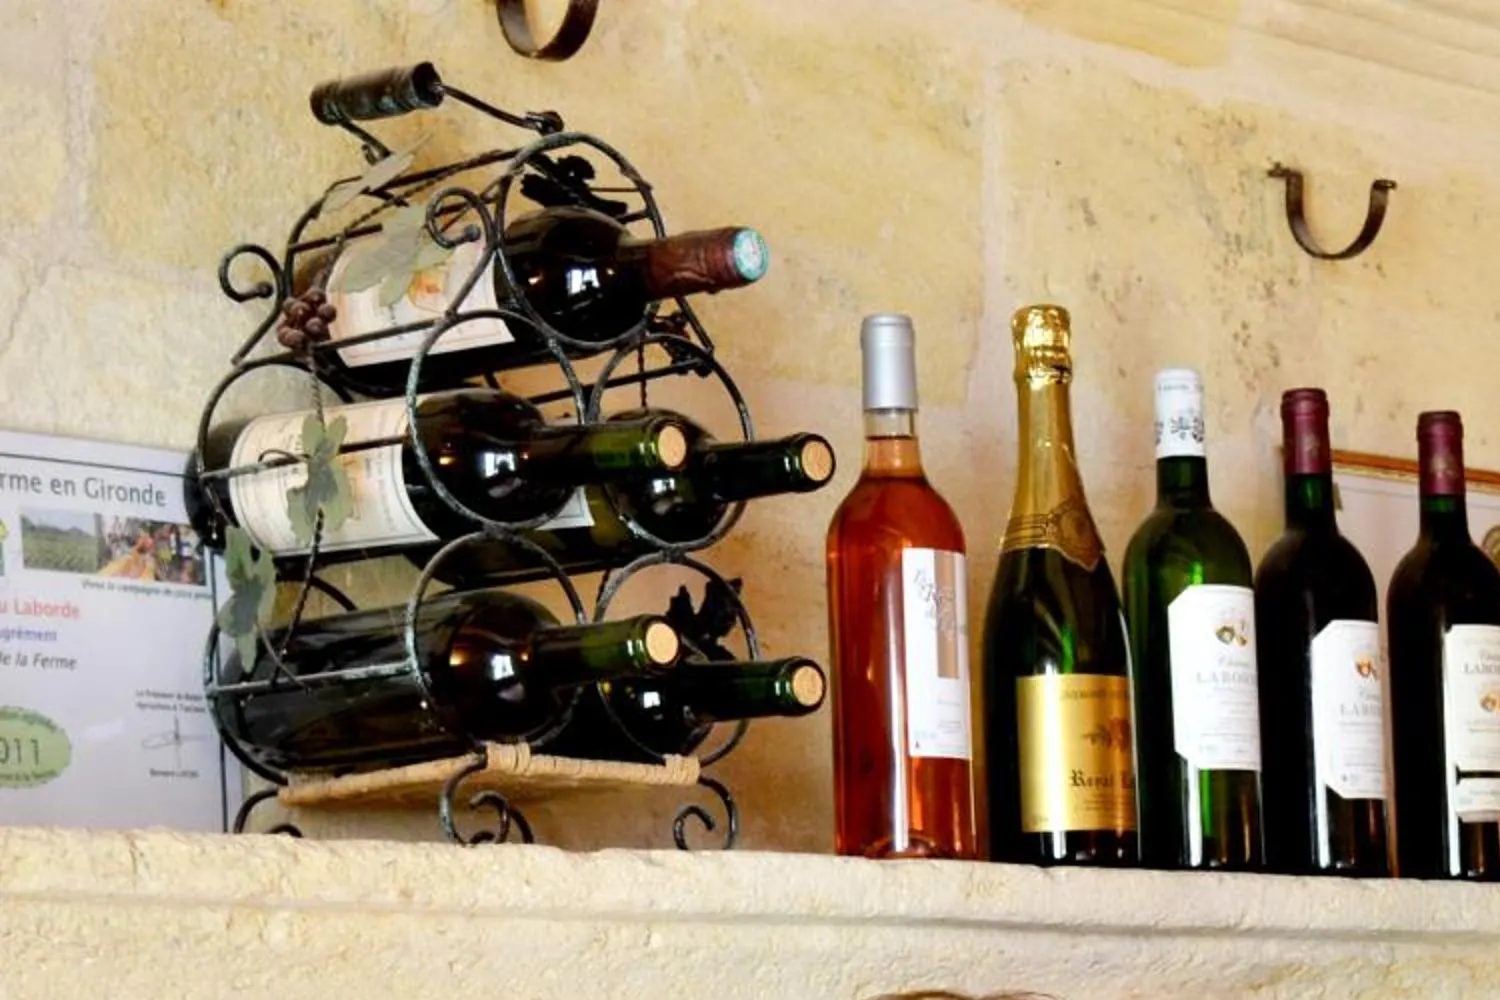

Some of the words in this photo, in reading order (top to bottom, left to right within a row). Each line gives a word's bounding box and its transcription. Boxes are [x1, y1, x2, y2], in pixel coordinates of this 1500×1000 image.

[50, 478, 76, 496] en
[84, 477, 166, 507] Gironde
[14, 600, 80, 619] Laborde
[15, 650, 29, 667] la
[33, 652, 78, 670] Ferme
